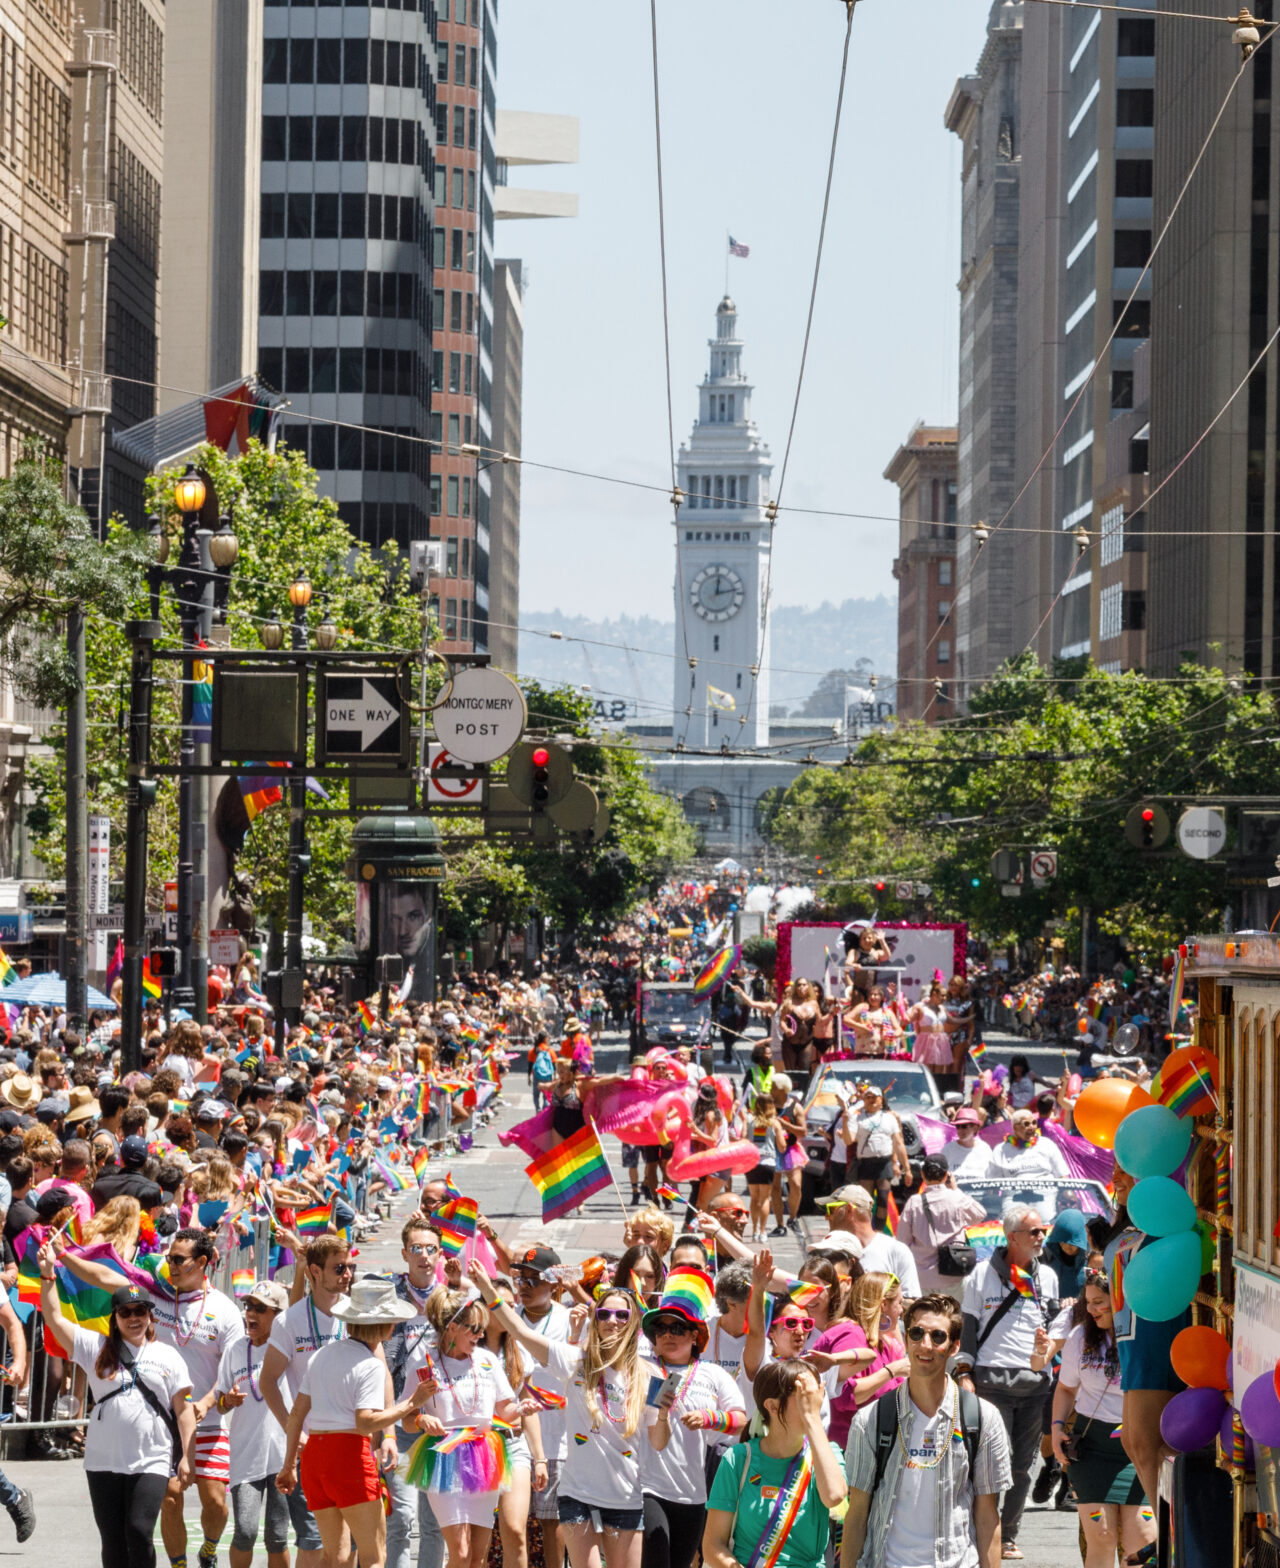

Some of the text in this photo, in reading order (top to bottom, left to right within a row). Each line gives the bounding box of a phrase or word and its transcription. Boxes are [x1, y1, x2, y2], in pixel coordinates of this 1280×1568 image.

[442, 697, 514, 710] MONTGOMERY
[329, 709, 392, 721] ONE WAY
[455, 723, 500, 736] POST
[1184, 828, 1222, 838] SECOND
[89, 874, 97, 945] Montgry
[98, 875, 108, 945] Montgry
[1057, 1180, 1088, 1190] BMW
